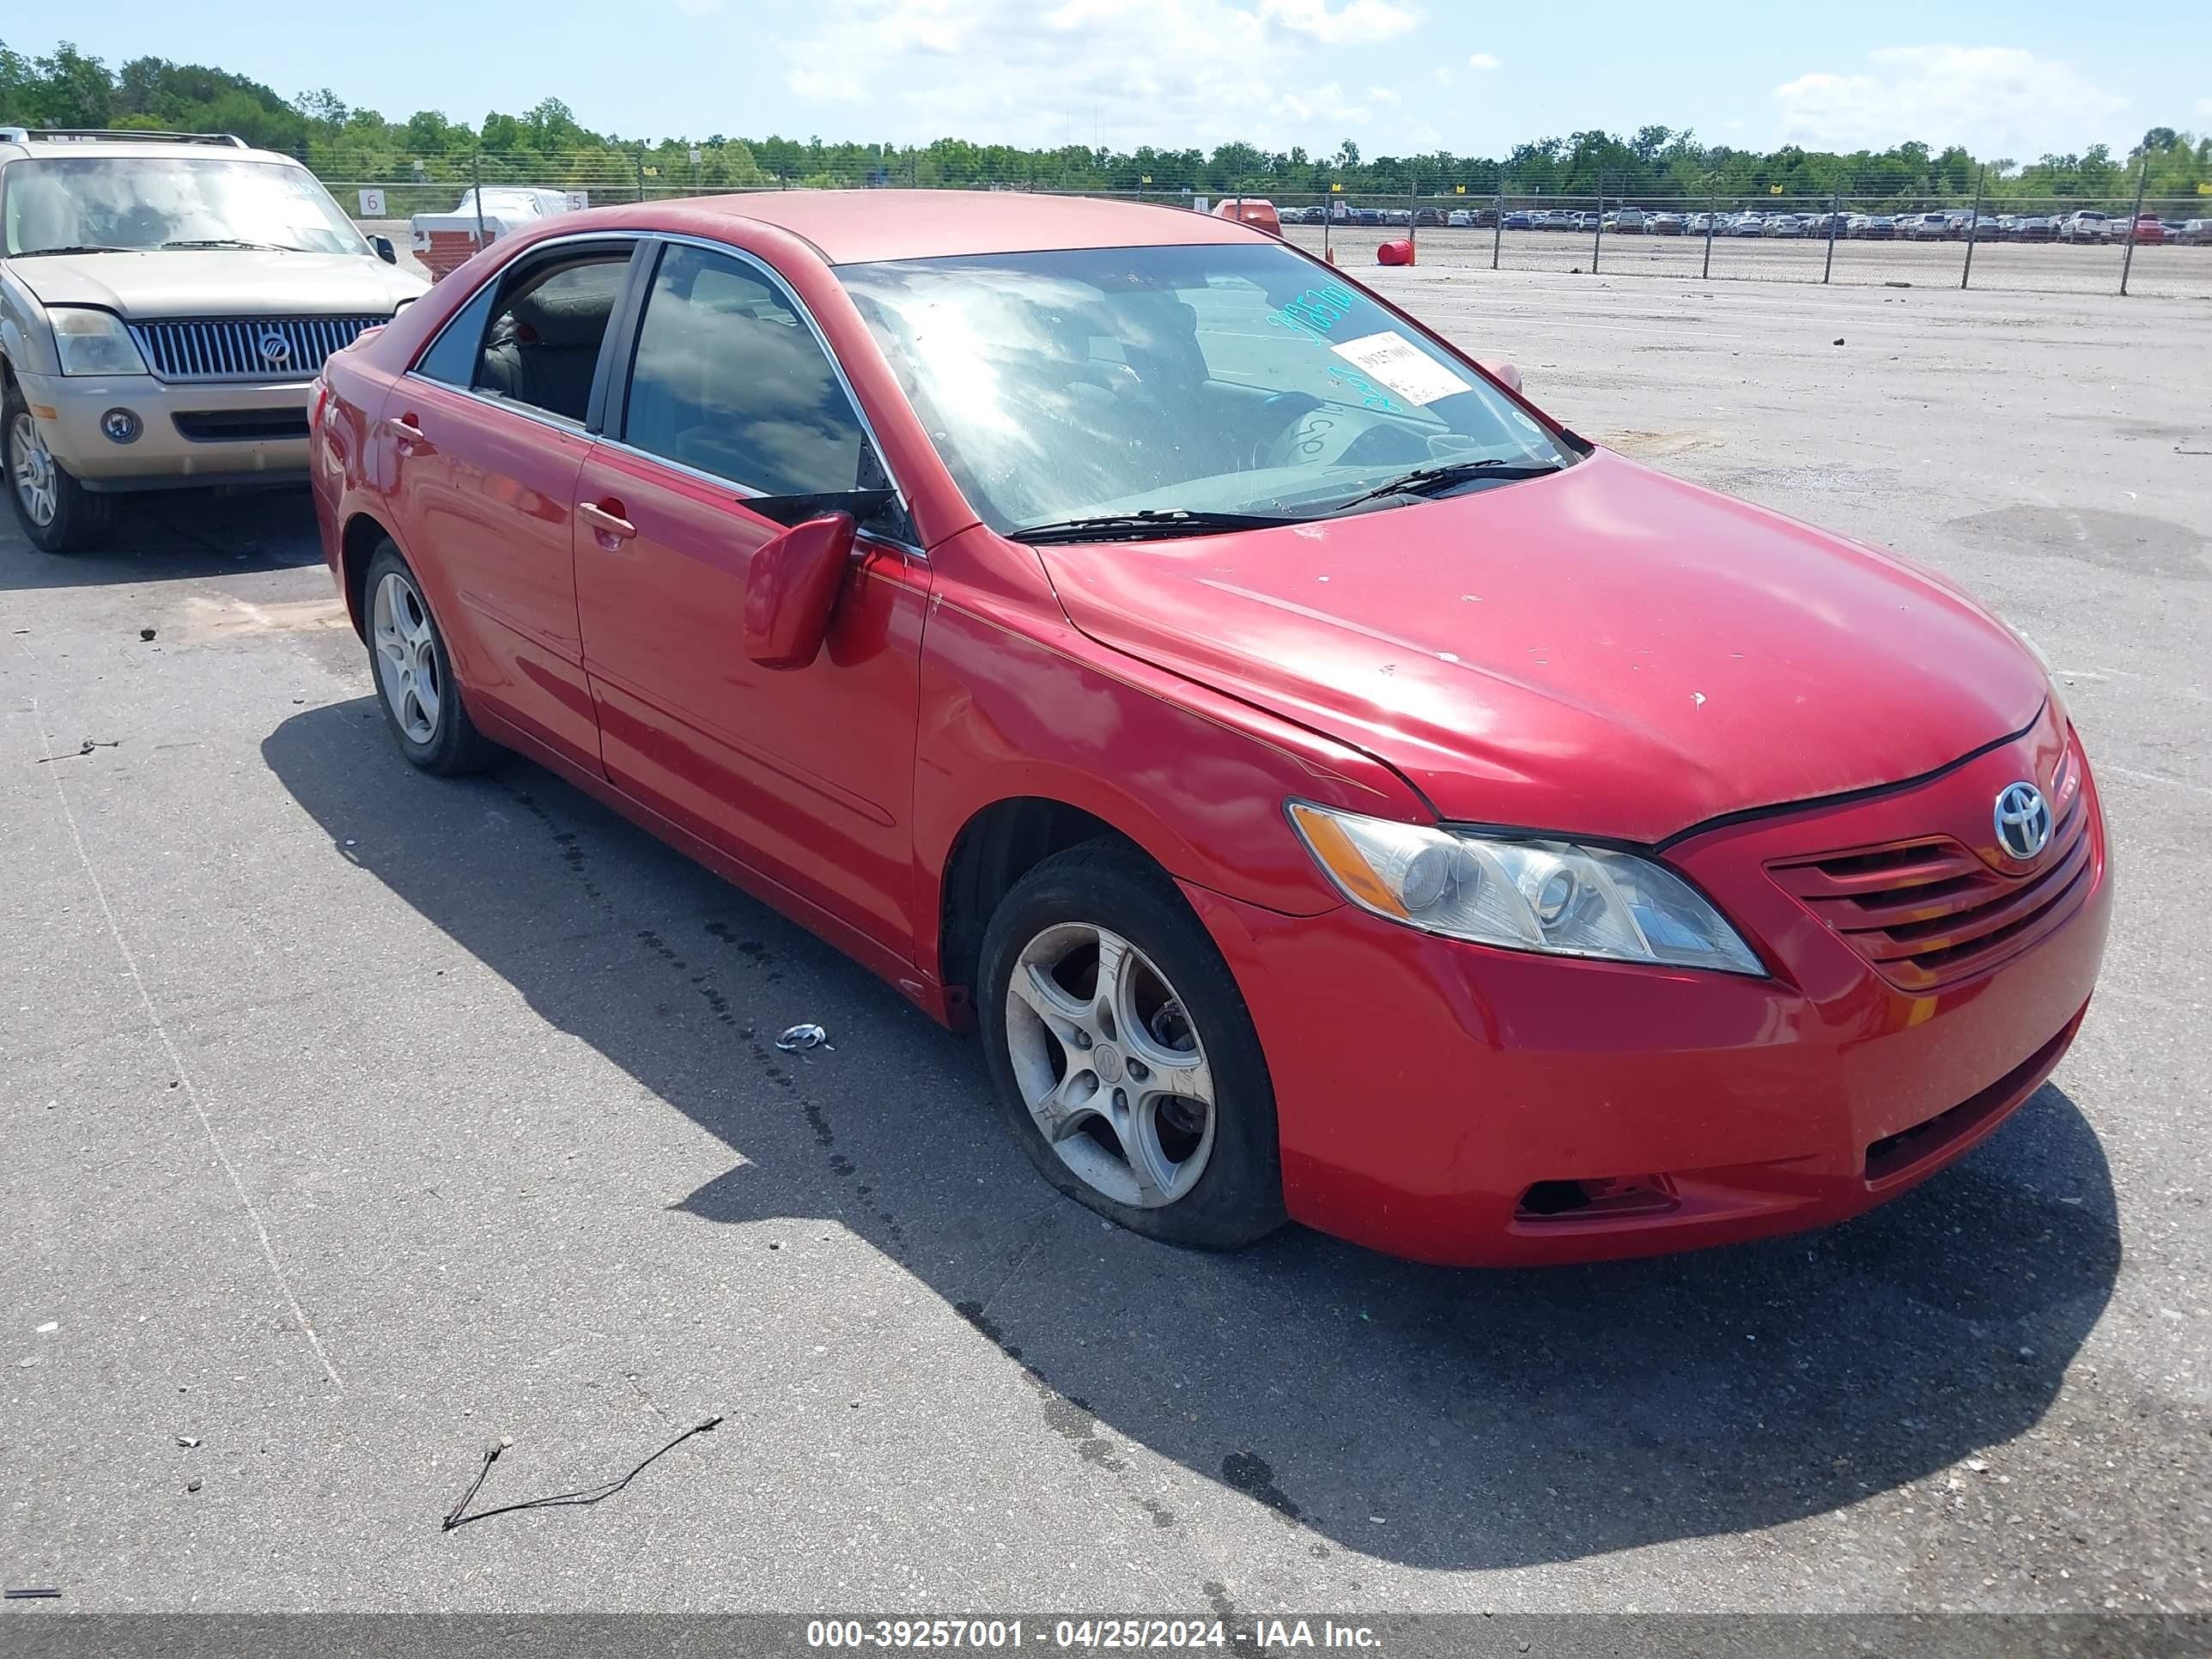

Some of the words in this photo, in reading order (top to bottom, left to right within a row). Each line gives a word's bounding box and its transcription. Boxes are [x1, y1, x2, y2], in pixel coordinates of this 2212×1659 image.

[368, 194, 378, 210] 6
[573, 196, 581, 210] 5
[1266, 276, 1367, 347] 39257001
